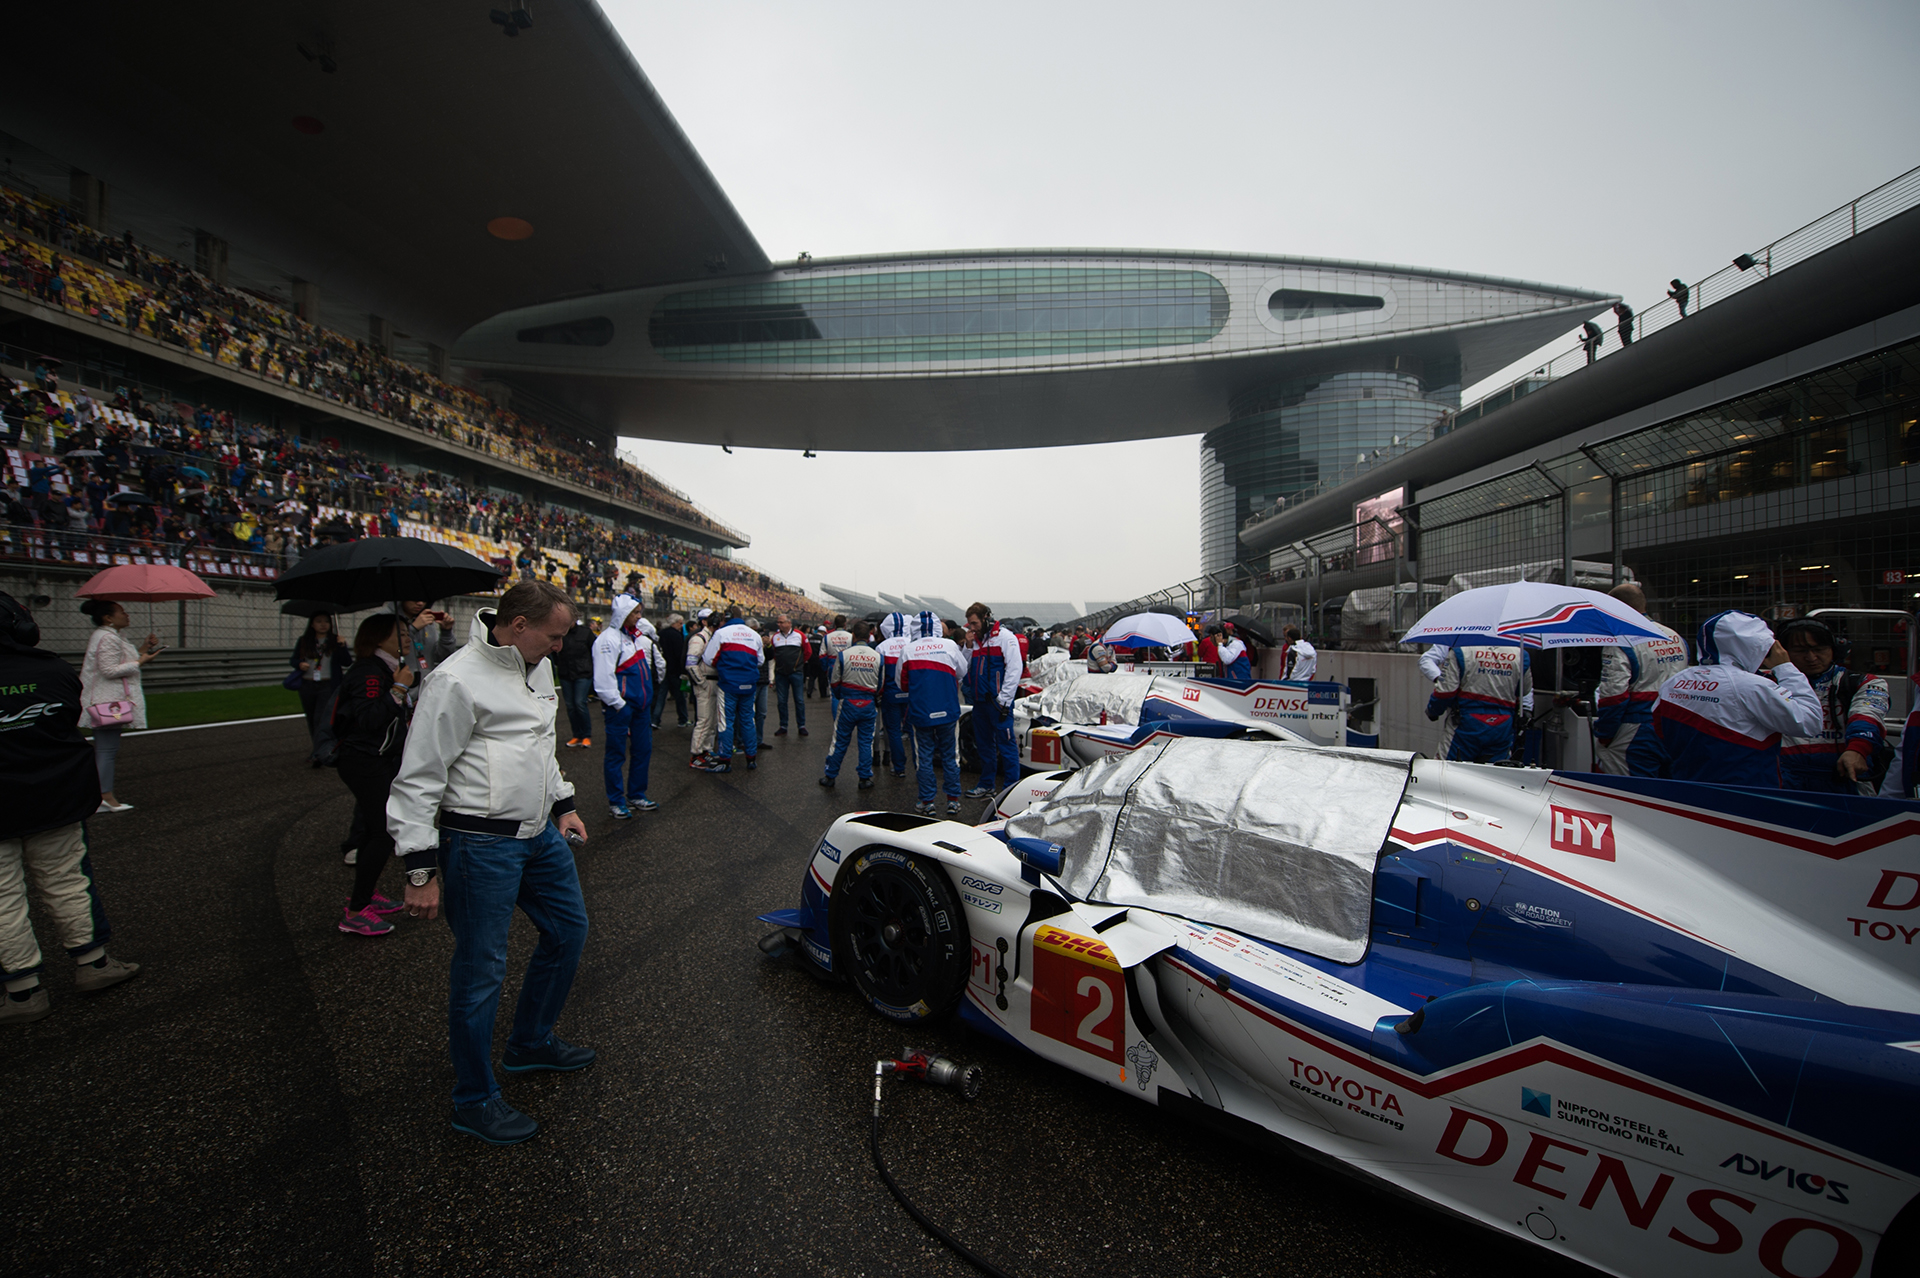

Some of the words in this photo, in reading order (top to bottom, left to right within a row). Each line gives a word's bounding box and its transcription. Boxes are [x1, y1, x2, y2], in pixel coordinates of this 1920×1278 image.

[1886, 571, 1902, 583] 83
[915, 643, 944, 651] DENSO
[1654, 646, 1683, 656] TOYOTA
[849, 654, 876, 662] DENSO
[1475, 650, 1516, 662] DENSO
[1125, 663, 1135, 672] HY
[1477, 666, 1513, 677] HYBRID
[1479, 660, 1513, 670] TOYOTA
[1674, 680, 1719, 692] DENSO
[1184, 688, 1200, 700] HY
[1309, 691, 1329, 699] Mobil
[1668, 692, 1690, 700] TOYOTA
[1690, 695, 1720, 704] HYBRID
[1311, 712, 1335, 720] JTEKT
[1046, 739, 1055, 762] 1
[1555, 810, 1609, 850] HY
[869, 850, 906, 863] MICHELIN
[962, 876, 1004, 895] RAYS
[1528, 905, 1560, 918] ACTION
[1525, 911, 1546, 920] ROAD
[1546, 915, 1573, 927] SAFETY
[1042, 930, 1115, 958] DHL
[945, 943, 954, 961] FL
[1320, 991, 1348, 1006] TAKATA
[1075, 976, 1115, 1052] 2
[1288, 1056, 1404, 1117] TOYOTA
[1289, 1079, 1343, 1106] GAZOO
[1347, 1103, 1405, 1132] Racing
[1558, 1099, 1609, 1122] NIPPON
[1613, 1116, 1655, 1135] STEEL
[1657, 1129, 1669, 1139] &
[1557, 1110, 1633, 1140] SUMITOMO
[1636, 1133, 1685, 1156] METAL
[1720, 1152, 1850, 1206] ADVICS
[1435, 1106, 1863, 1278] DENSO
